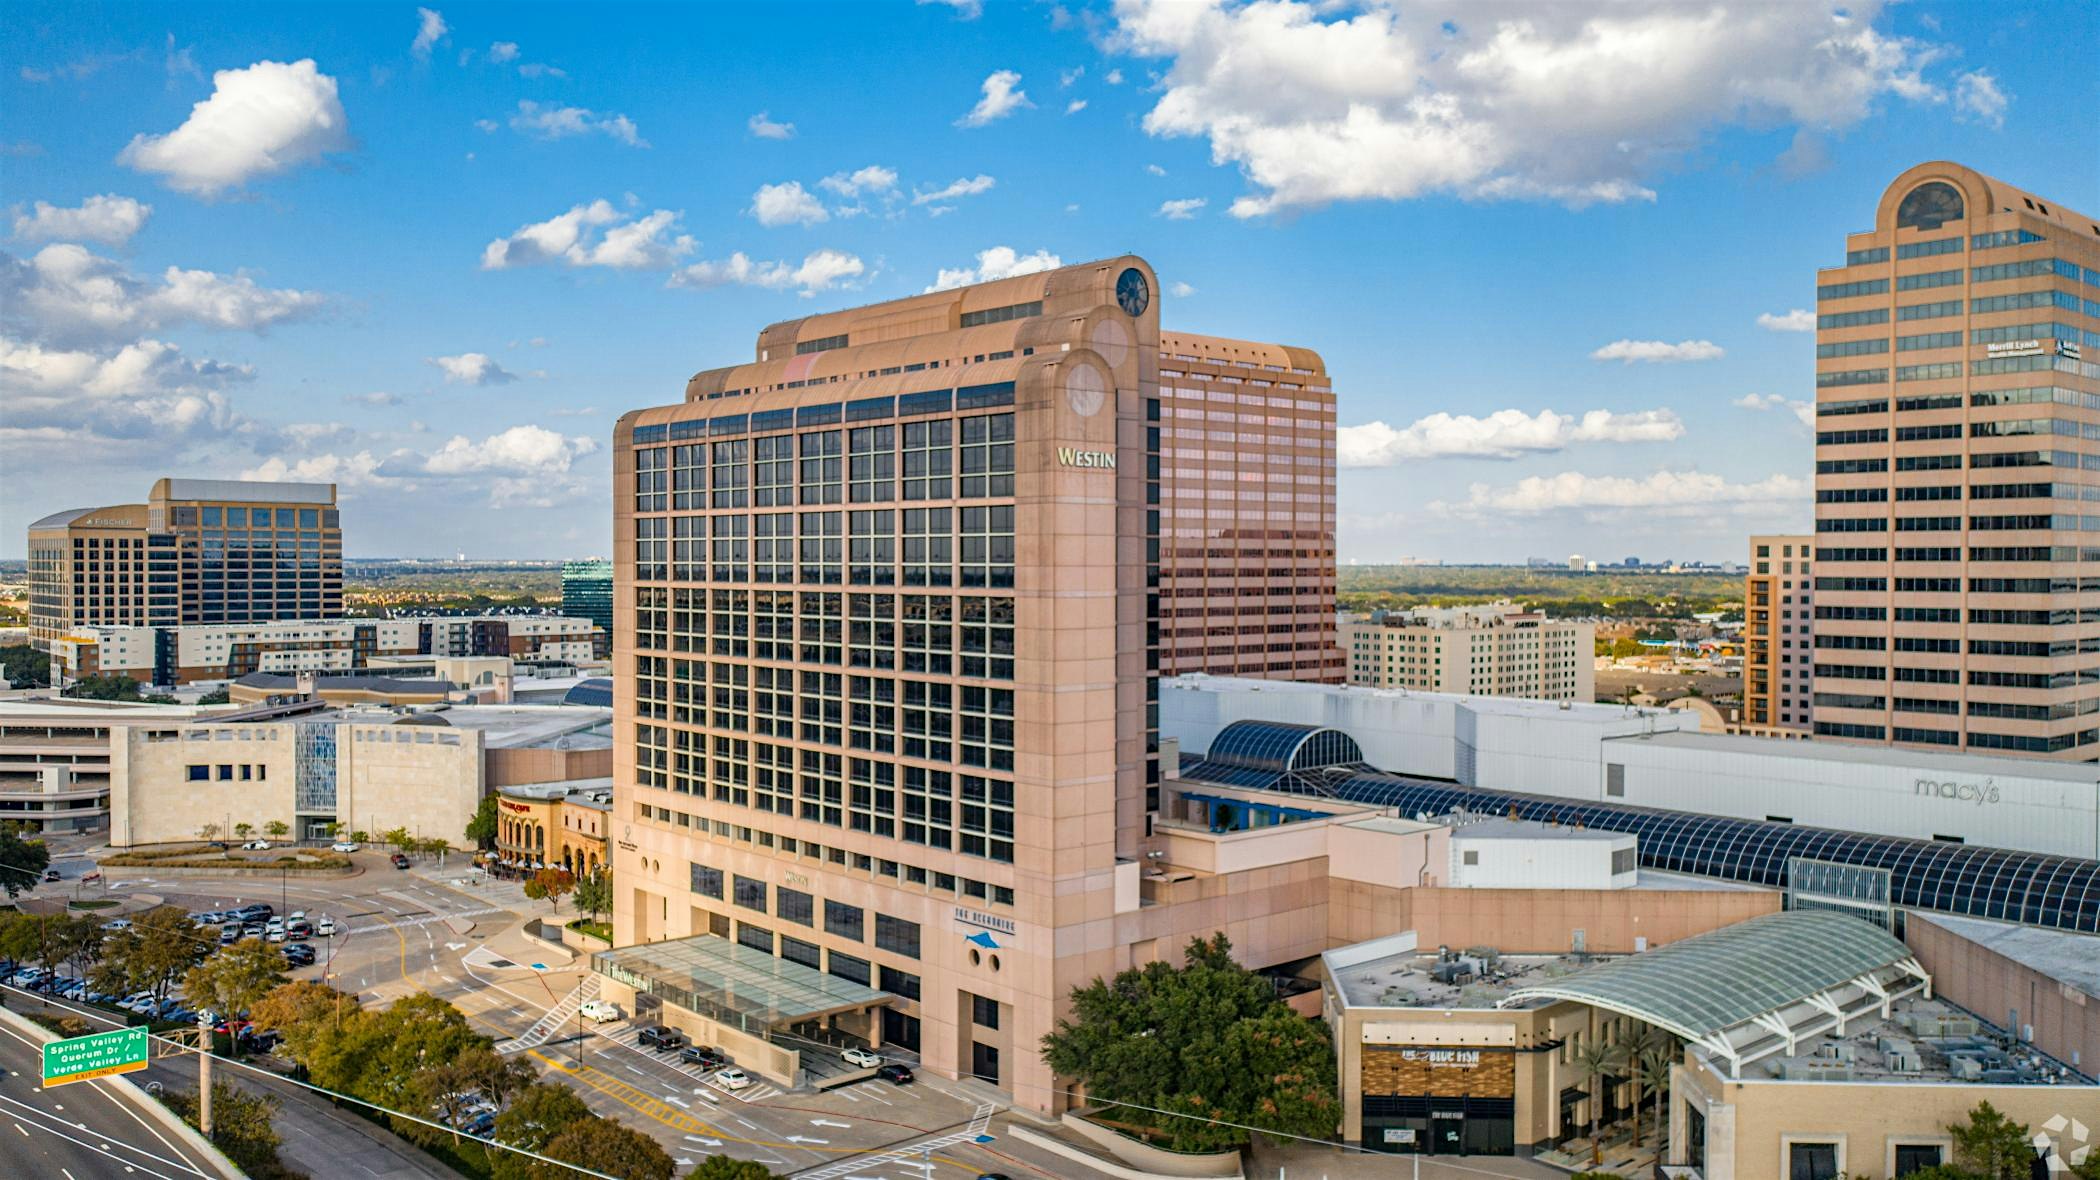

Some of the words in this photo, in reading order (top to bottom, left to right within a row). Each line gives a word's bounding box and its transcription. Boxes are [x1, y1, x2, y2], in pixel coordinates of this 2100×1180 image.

[1057, 447, 1116, 469] WESTIN
[1914, 777, 2000, 806] macy's
[50, 1043, 86, 1056] Spring
[91, 1036, 124, 1048] Valley
[128, 1032, 142, 1041] Rd
[61, 1050, 102, 1063] Quorum
[107, 1046, 119, 1055] Dr
[53, 1063, 83, 1075] Verde
[89, 1056, 122, 1068] Valley
[126, 1053, 139, 1061] Ln
[1430, 1049, 1454, 1062] BLUE
[75, 1072, 92, 1080] EXIT
[96, 1068, 117, 1077] ONLY
